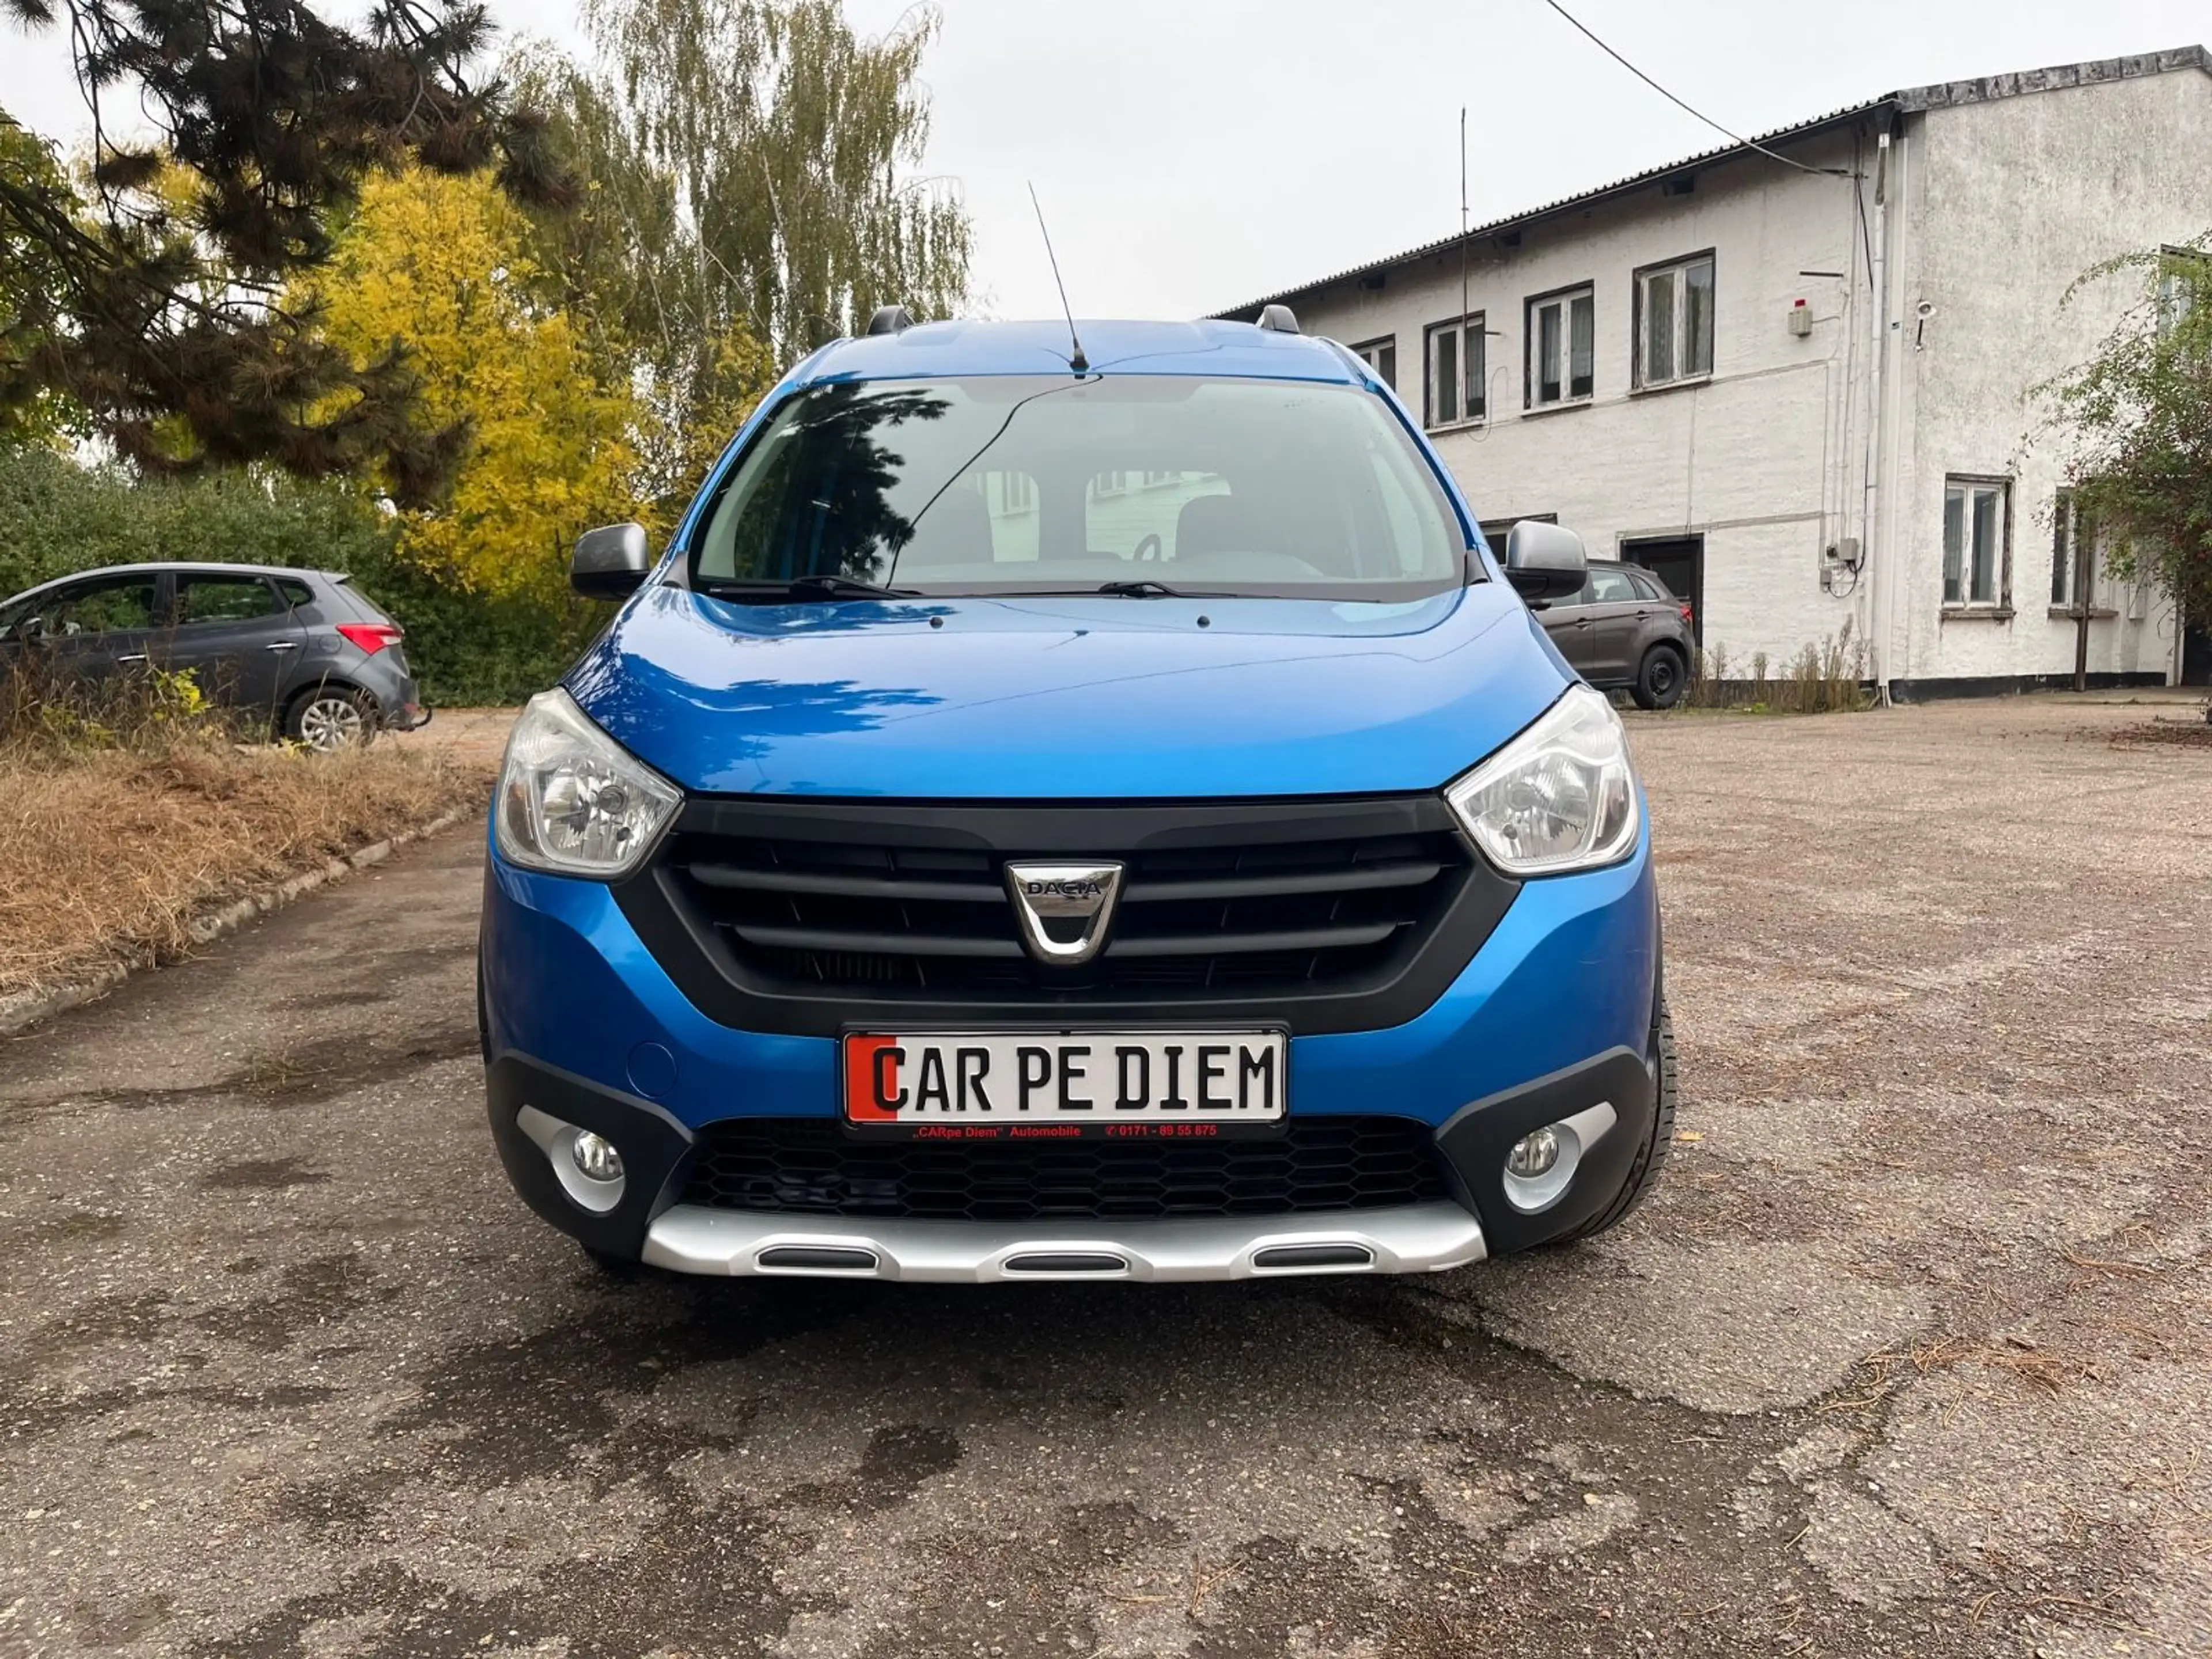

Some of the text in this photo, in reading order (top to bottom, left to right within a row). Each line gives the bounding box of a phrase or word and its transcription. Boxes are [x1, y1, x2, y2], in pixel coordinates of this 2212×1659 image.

[1027, 882, 1101, 899] DACIA
[872, 1045, 1274, 1111] CAR PE DIEM
[1010, 1126, 1081, 1137] Automobile
[1119, 1125, 1147, 1136] 0171
[1177, 1125, 1191, 1136] 55
